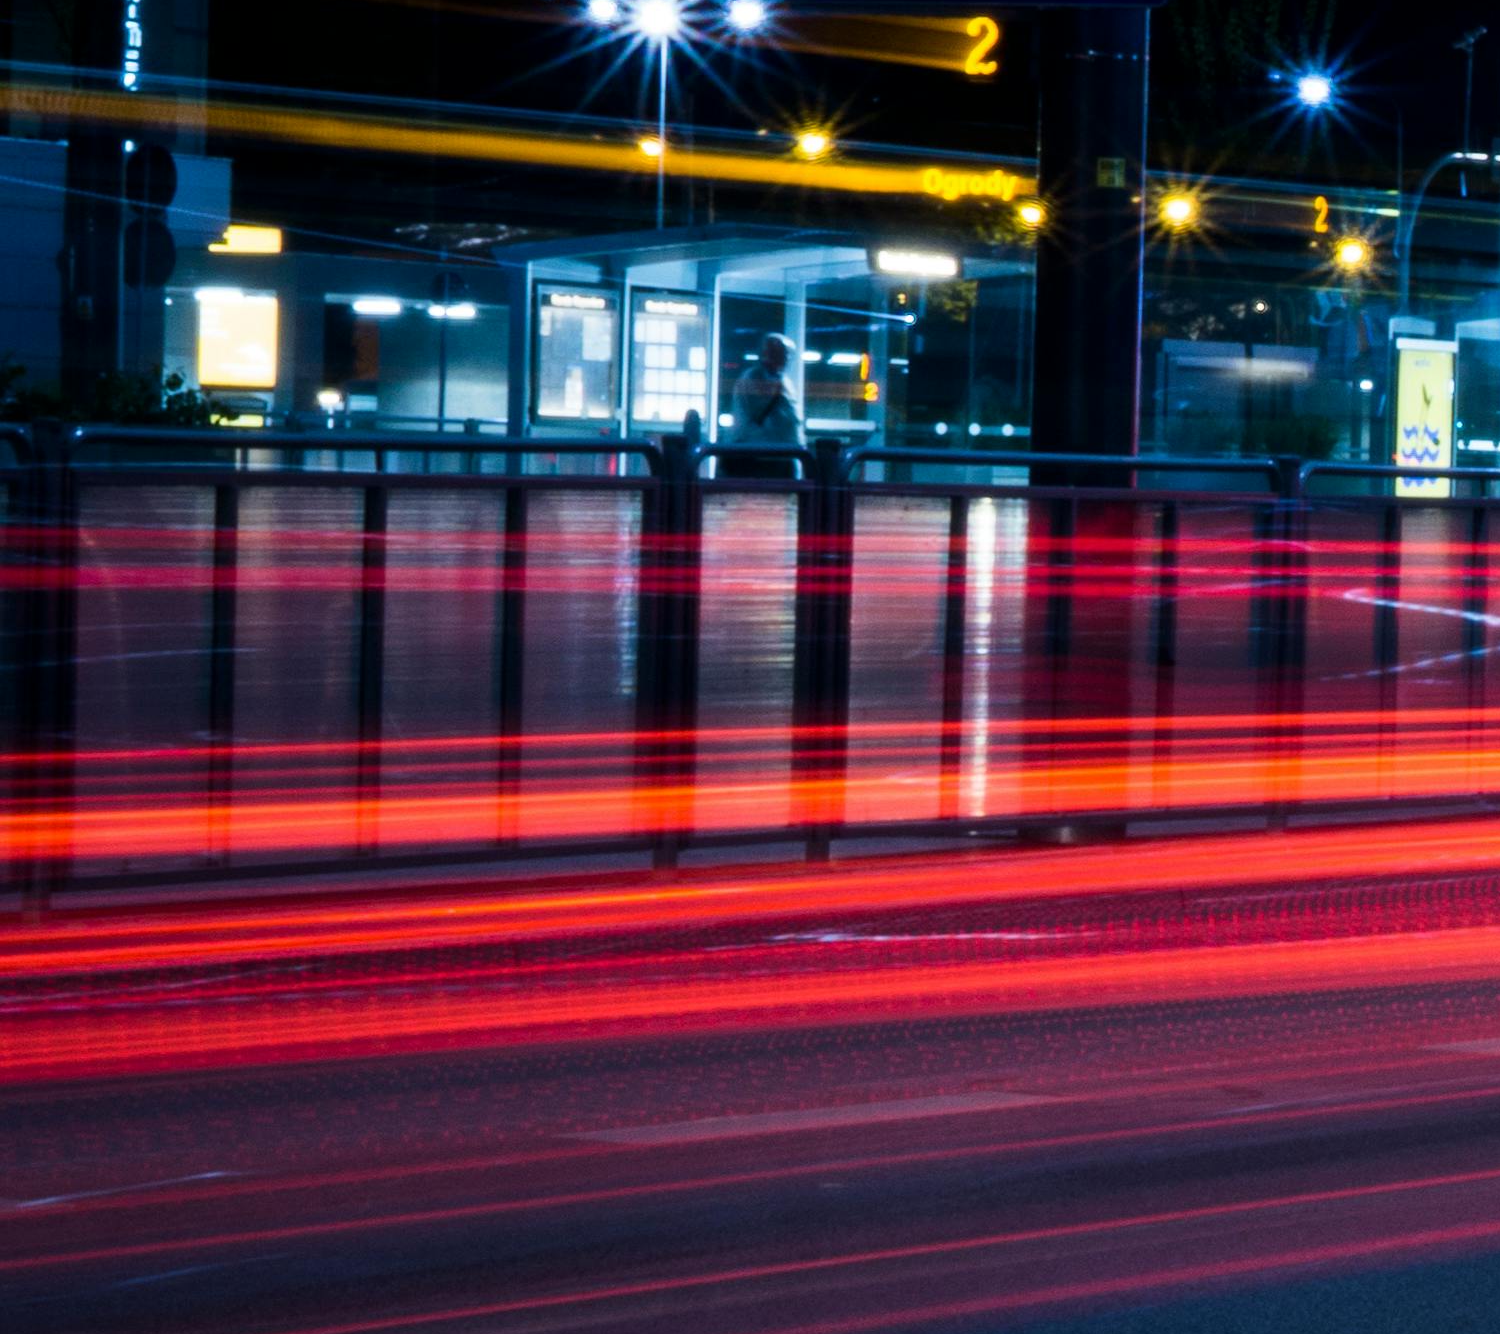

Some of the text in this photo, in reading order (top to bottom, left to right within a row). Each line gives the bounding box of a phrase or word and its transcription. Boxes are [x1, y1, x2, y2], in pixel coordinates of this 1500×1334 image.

[964, 16, 999, 75] 2
[923, 168, 1018, 201] Ogrody
[1313, 195, 1329, 234] 2
